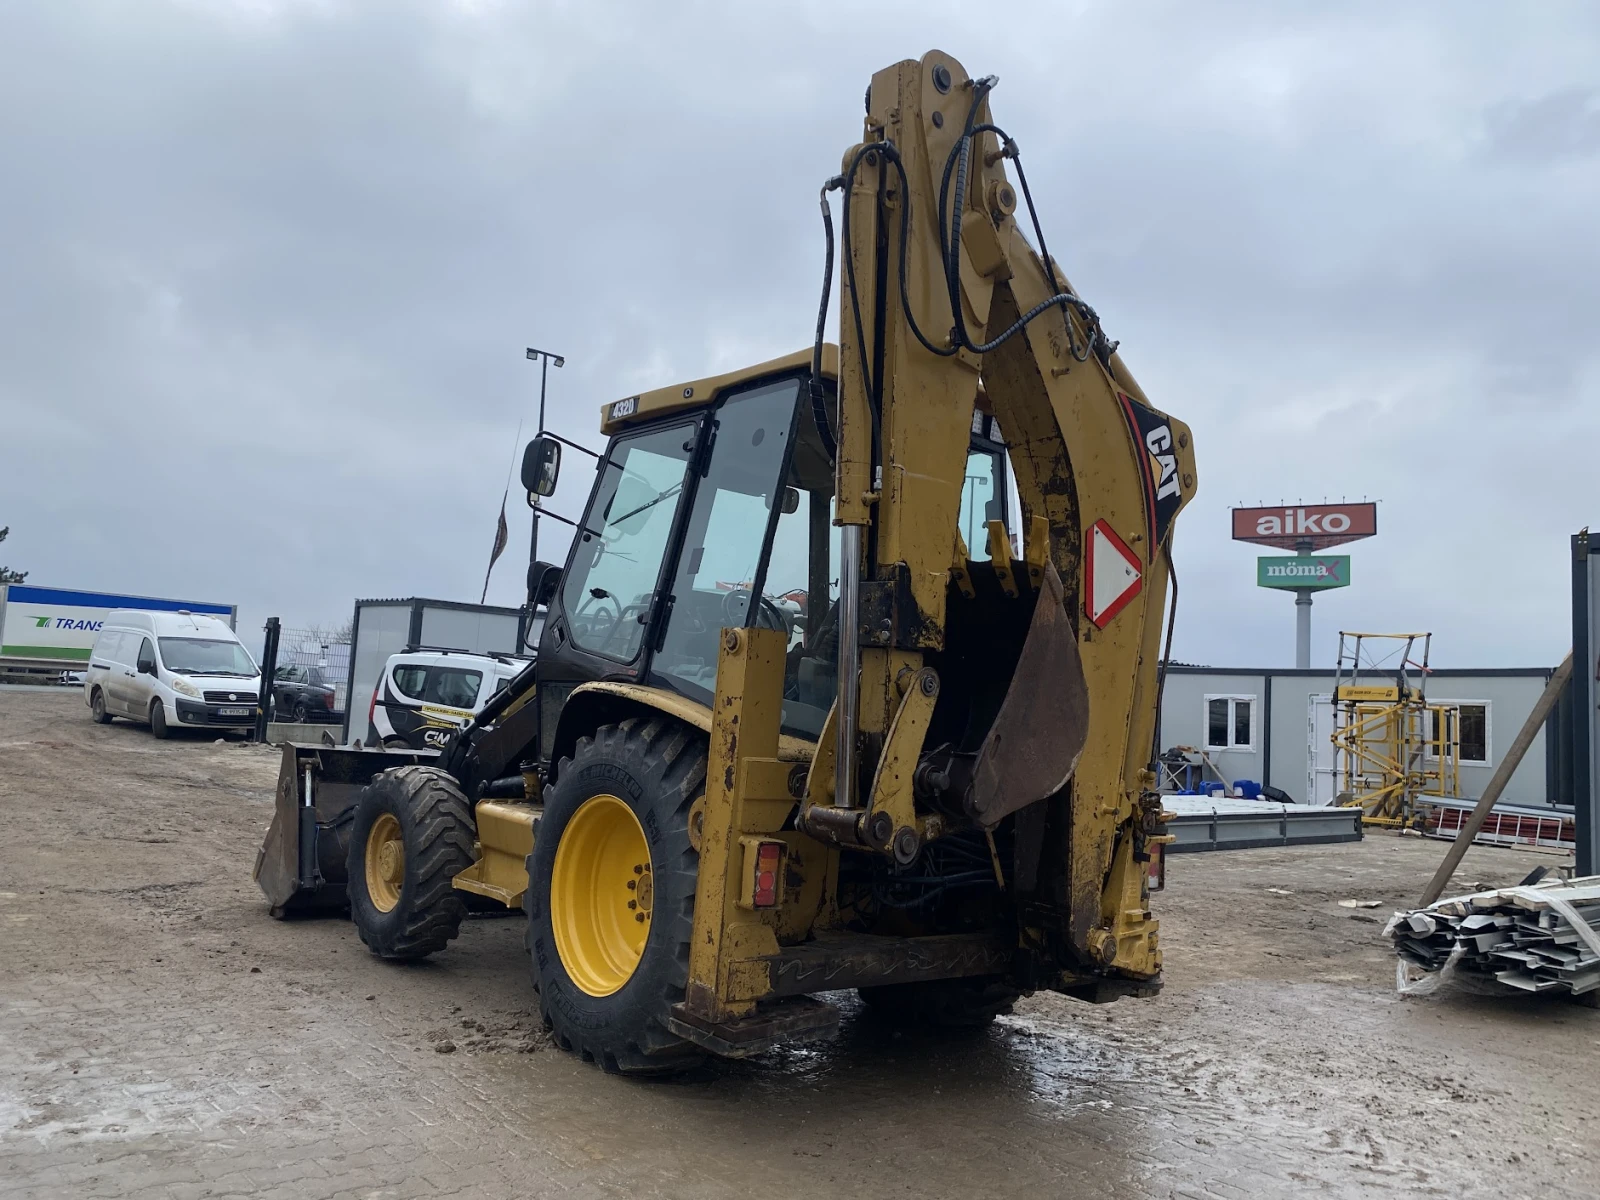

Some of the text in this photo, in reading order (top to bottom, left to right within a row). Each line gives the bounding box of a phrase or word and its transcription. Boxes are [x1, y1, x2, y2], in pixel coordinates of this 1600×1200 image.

[613, 398, 635, 418] 432D
[1146, 425, 1181, 501] CAT
[1256, 509, 1351, 535] aiko
